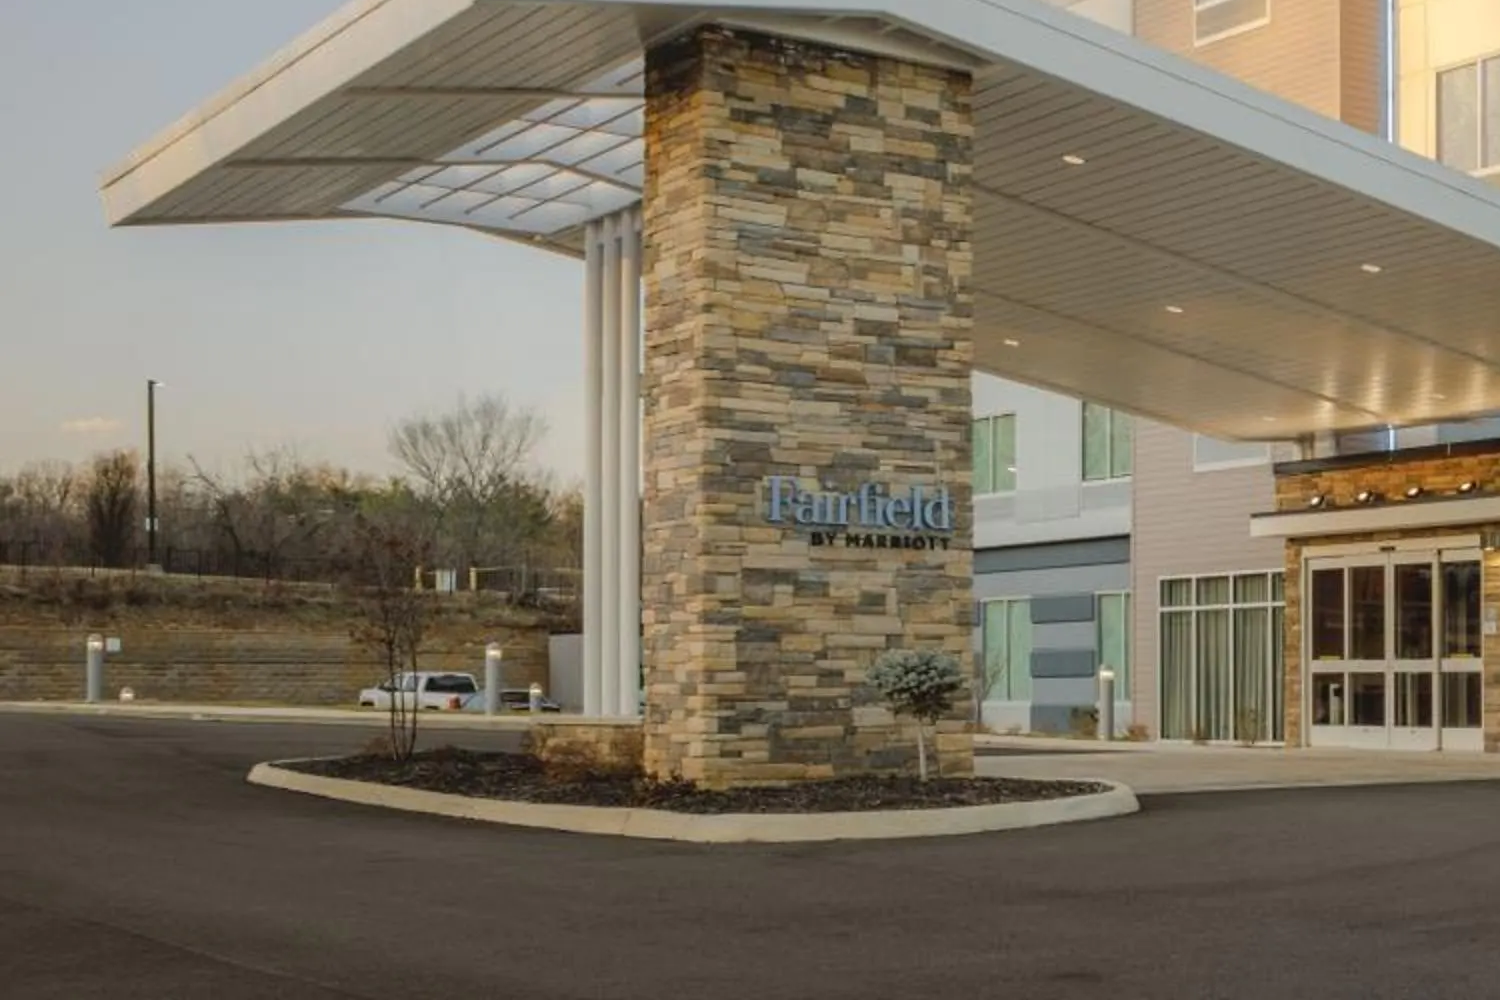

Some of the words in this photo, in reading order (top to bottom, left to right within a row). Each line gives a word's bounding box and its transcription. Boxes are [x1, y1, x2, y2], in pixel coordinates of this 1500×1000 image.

[767, 474, 952, 531] Fairfield
[811, 532, 835, 547] BY
[845, 533, 951, 550] MARRIOTT
